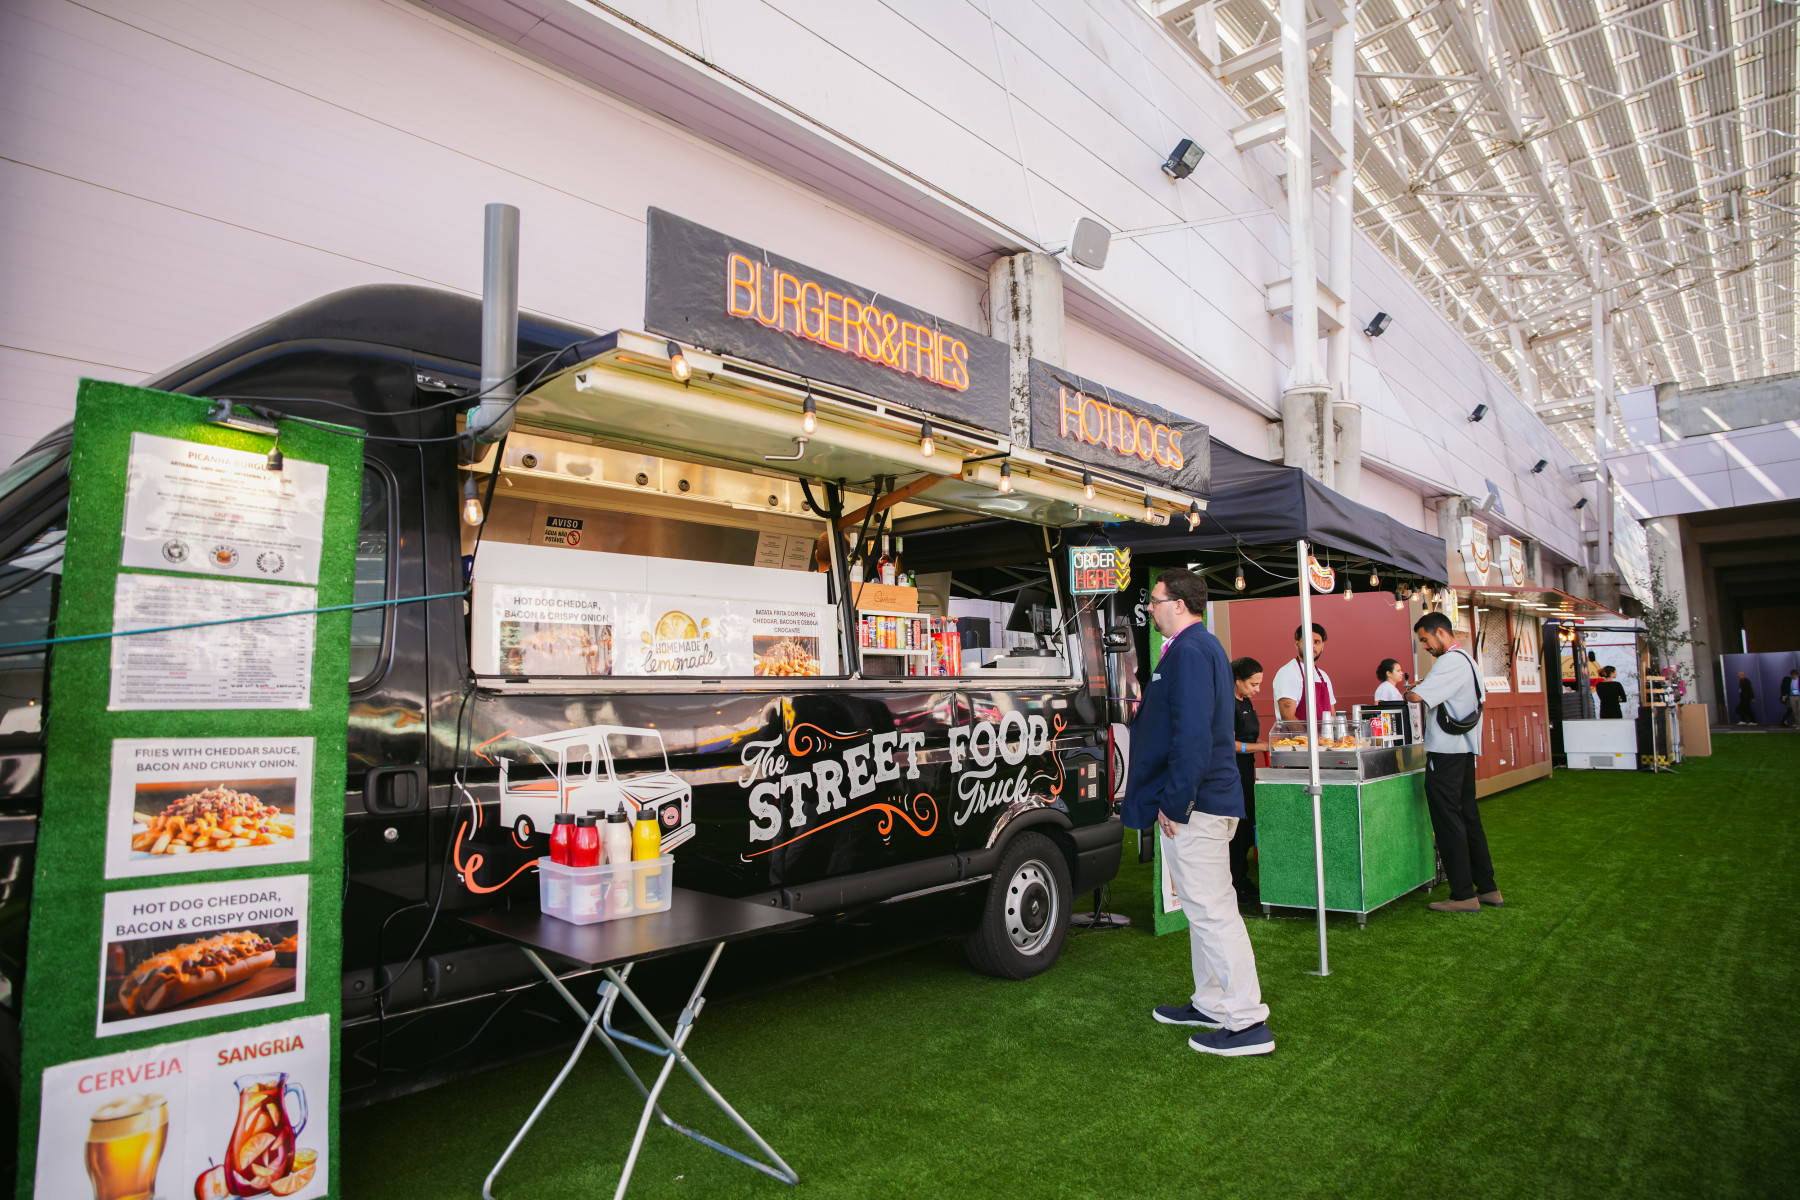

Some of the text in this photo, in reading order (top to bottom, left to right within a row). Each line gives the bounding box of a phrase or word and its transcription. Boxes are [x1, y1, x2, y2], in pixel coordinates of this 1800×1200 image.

[728, 254, 969, 391] BURGERS&FRIES
[188, 451, 231, 465] PICANHA
[552, 518, 578, 528] AVISO
[1074, 552, 1115, 568] ORDER
[1076, 569, 1116, 589] HERE
[514, 597, 601, 610] HOT DOG CHEDDAR,
[504, 610, 538, 619] BACON
[548, 612, 579, 621] CRISPY
[581, 613, 609, 622] ONION
[655, 641, 701, 654] HOMEMADE
[135, 745, 301, 758] FRIES WITH CHEDDAR SAUCE,
[136, 759, 298, 772] BACON AND CRUNKY ONION.
[738, 733, 788, 789] The
[749, 710, 1048, 843] STREET FOOD
[954, 763, 1030, 826] Truck
[133, 891, 281, 916] HOT DOG CHEDDAR,
[115, 907, 294, 937] BACON & CRISPY ONION
[77, 1057, 183, 1095] CERVEJA
